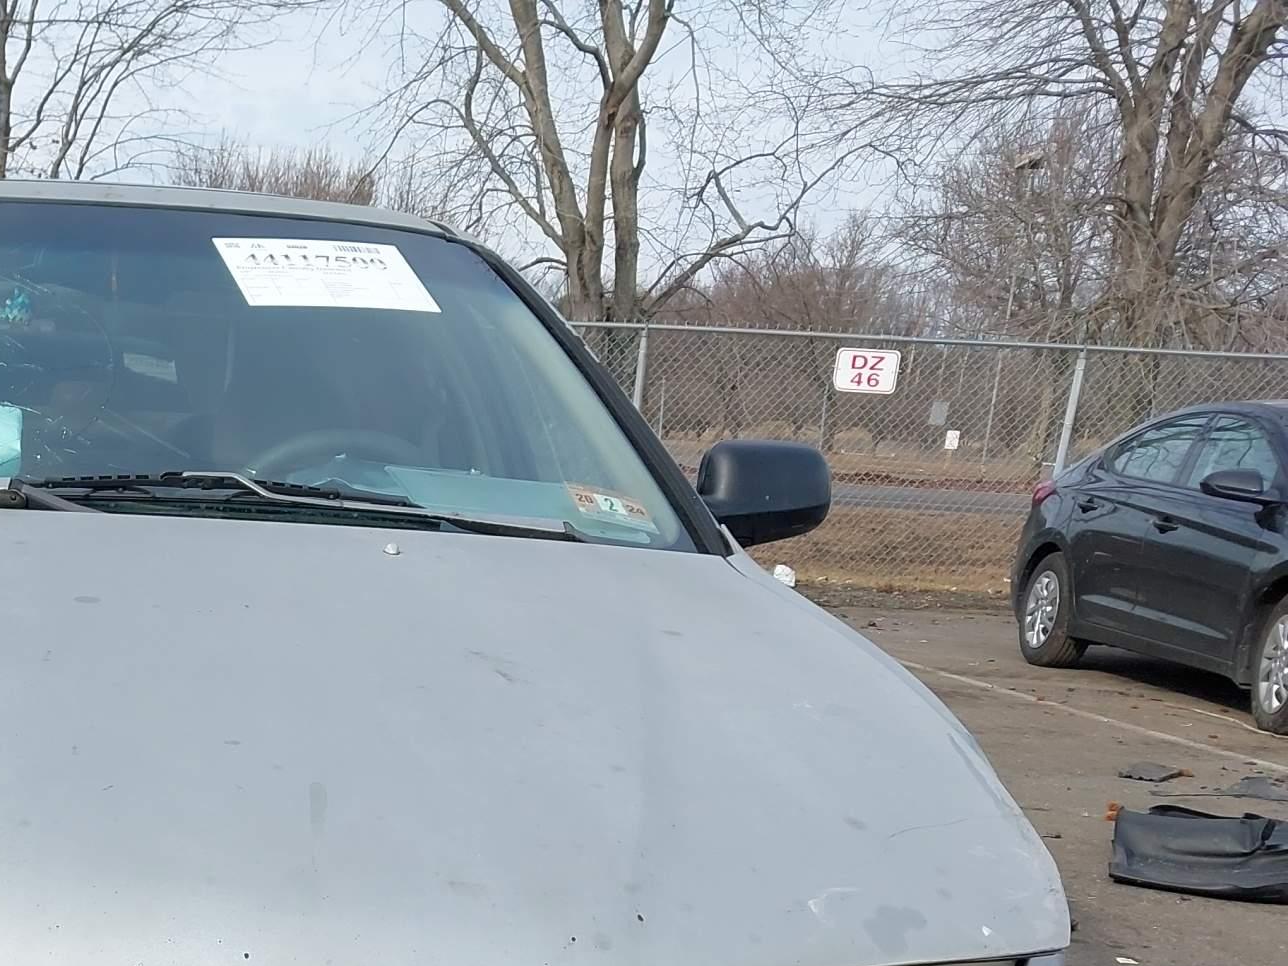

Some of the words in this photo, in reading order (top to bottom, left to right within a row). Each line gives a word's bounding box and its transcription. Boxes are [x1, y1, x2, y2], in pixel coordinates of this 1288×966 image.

[851, 354, 885, 371] DZ
[850, 372, 880, 388] 46
[575, 493, 594, 504] 20
[604, 497, 619, 513] 2
